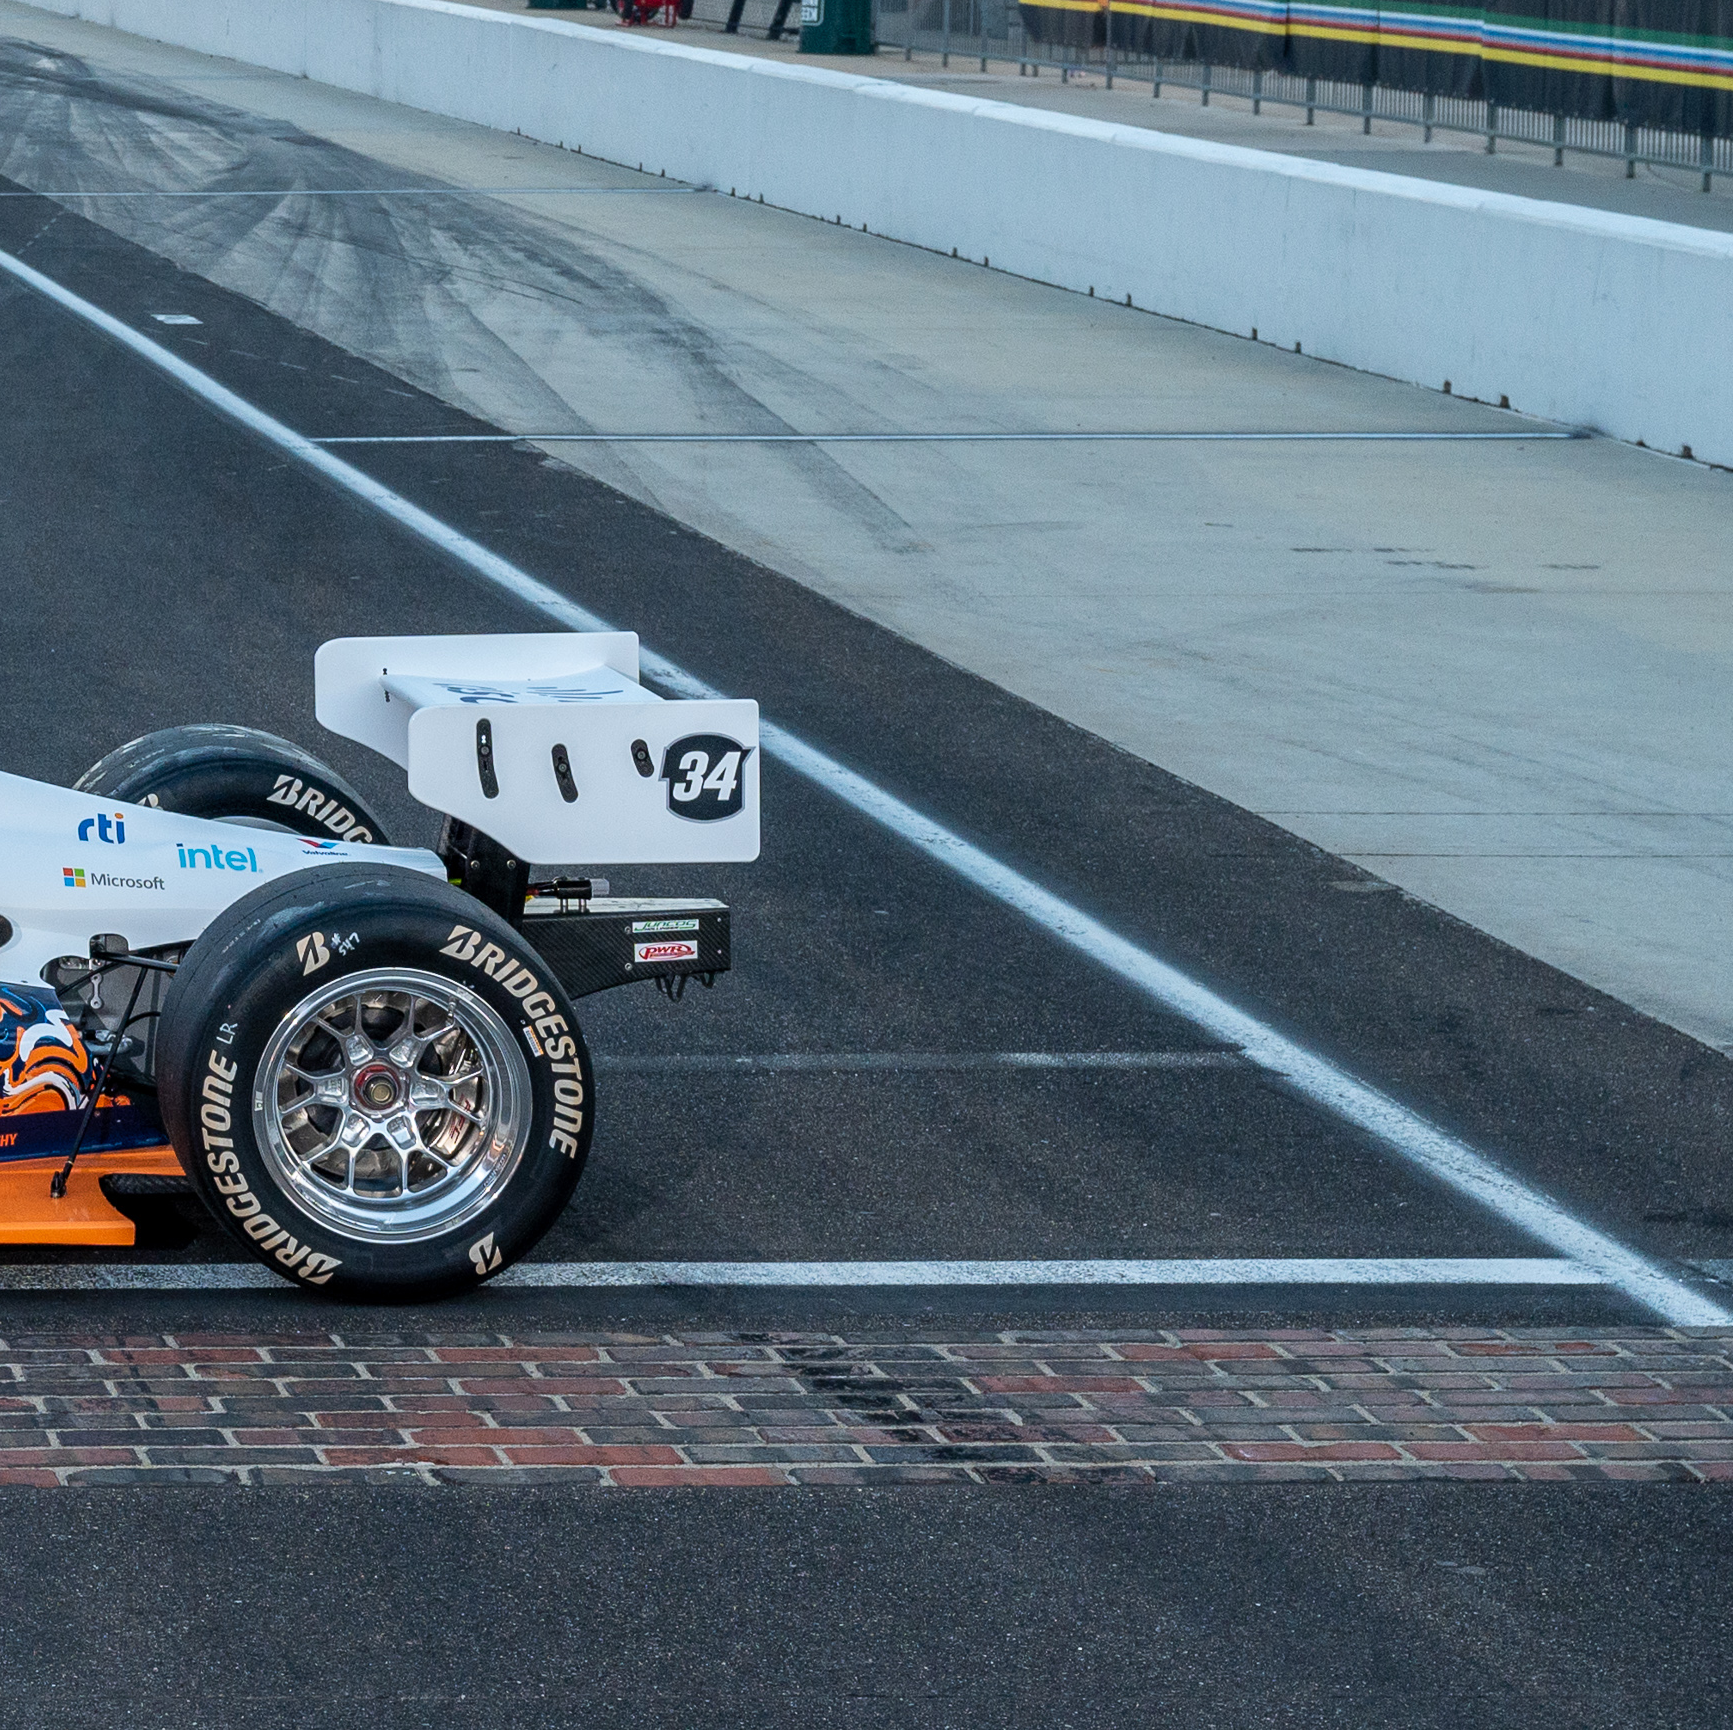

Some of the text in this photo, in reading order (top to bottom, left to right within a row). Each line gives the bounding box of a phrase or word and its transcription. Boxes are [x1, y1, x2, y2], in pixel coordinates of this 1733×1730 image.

[672, 751, 742, 802] 34
[78, 812, 125, 844] rti
[176, 843, 258, 873] intel
[90, 872, 165, 890] Microsoft
[644, 946, 682, 960] PWR
[215, 1021, 237, 1045] LR
[439, 924, 583, 1159] BRIDGESTONE
[201, 1049, 343, 1285] BRIDGESTONE
